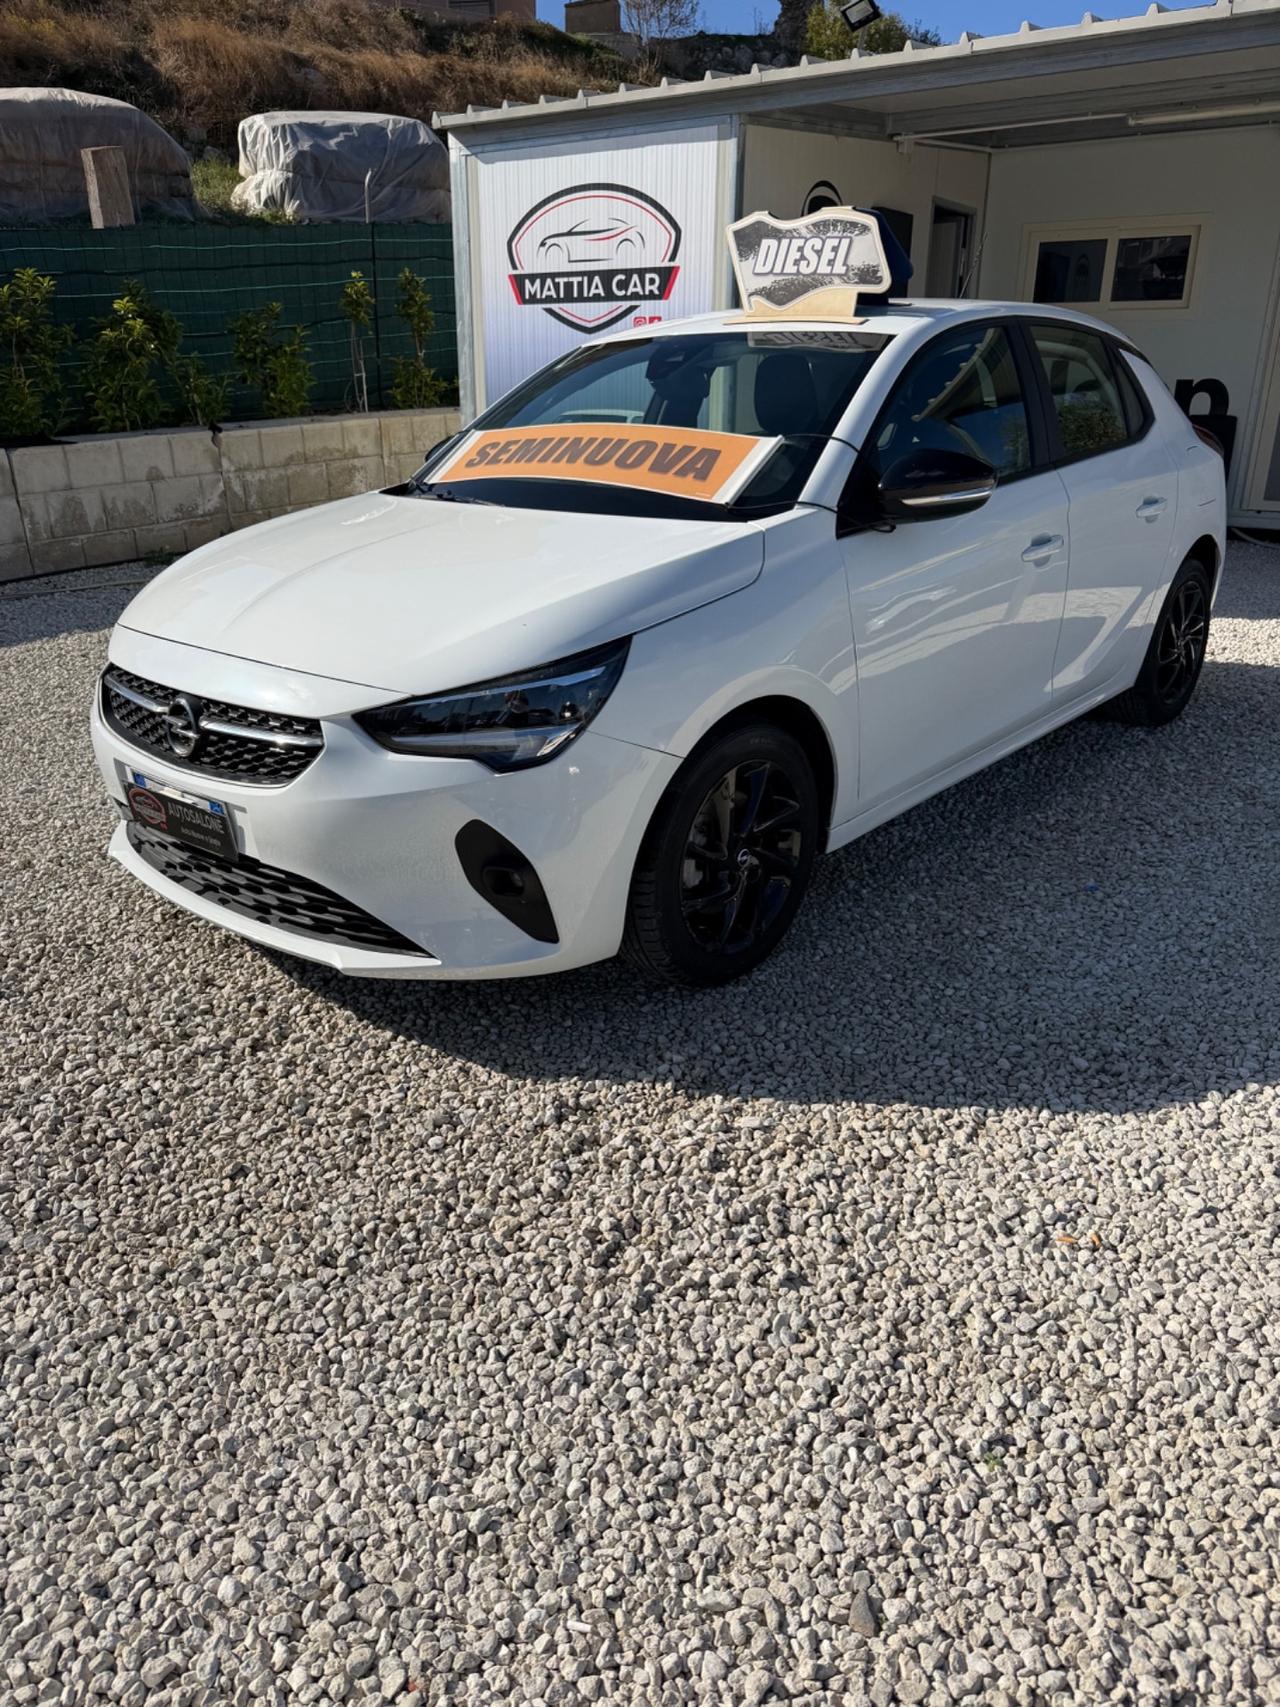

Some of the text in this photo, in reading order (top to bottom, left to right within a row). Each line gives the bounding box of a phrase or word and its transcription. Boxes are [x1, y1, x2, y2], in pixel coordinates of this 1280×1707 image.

[752, 236, 852, 275] DIESEL
[525, 273, 661, 300] MATTIA CAR
[466, 436, 722, 481] SEMINUOVA
[167, 801, 225, 835] AUTOSALONE
